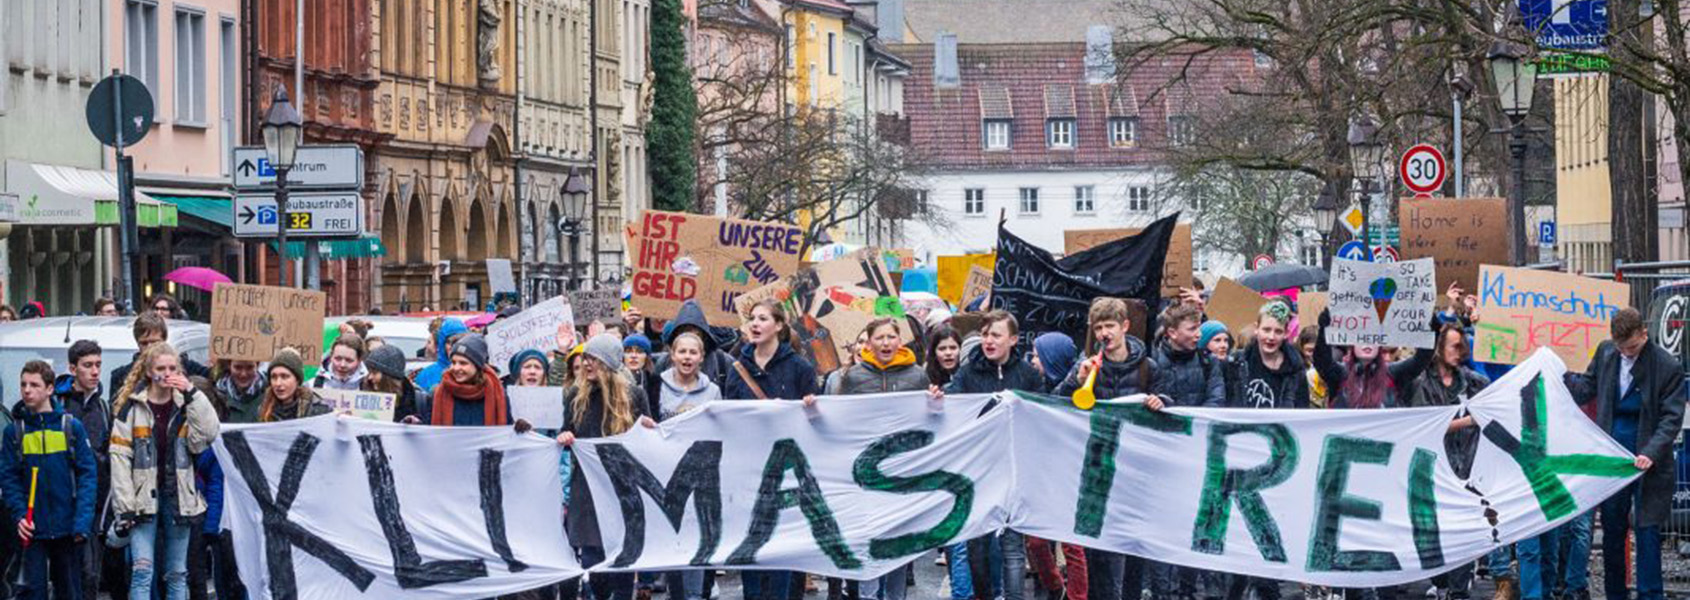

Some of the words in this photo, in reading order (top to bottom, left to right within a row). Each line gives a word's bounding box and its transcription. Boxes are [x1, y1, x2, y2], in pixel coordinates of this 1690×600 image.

[293, 162, 327, 172] ntrum
[1410, 158, 1436, 179] 30
[262, 213, 272, 223] P
[285, 199, 353, 209] eubaustraße
[1410, 209, 1457, 230] Home
[1472, 214, 1483, 228] is
[291, 214, 309, 229] 32
[325, 218, 351, 229] FREI
[643, 213, 686, 240] IST
[719, 221, 801, 254] UNSERE
[638, 240, 680, 271] IHR
[1400, 263, 1415, 275] SO
[633, 271, 697, 301] GELD
[1405, 273, 1432, 288] TAKE
[993, 295, 1019, 313] DIE
[1330, 291, 1372, 309] getting
[1397, 291, 1416, 301] OFF
[1332, 315, 1370, 330] HOT
[1393, 308, 1426, 319] YOUR
[1331, 334, 1347, 343] IN
[1357, 334, 1388, 345] HERE
[222, 370, 1638, 600] KLIMASTREIK
